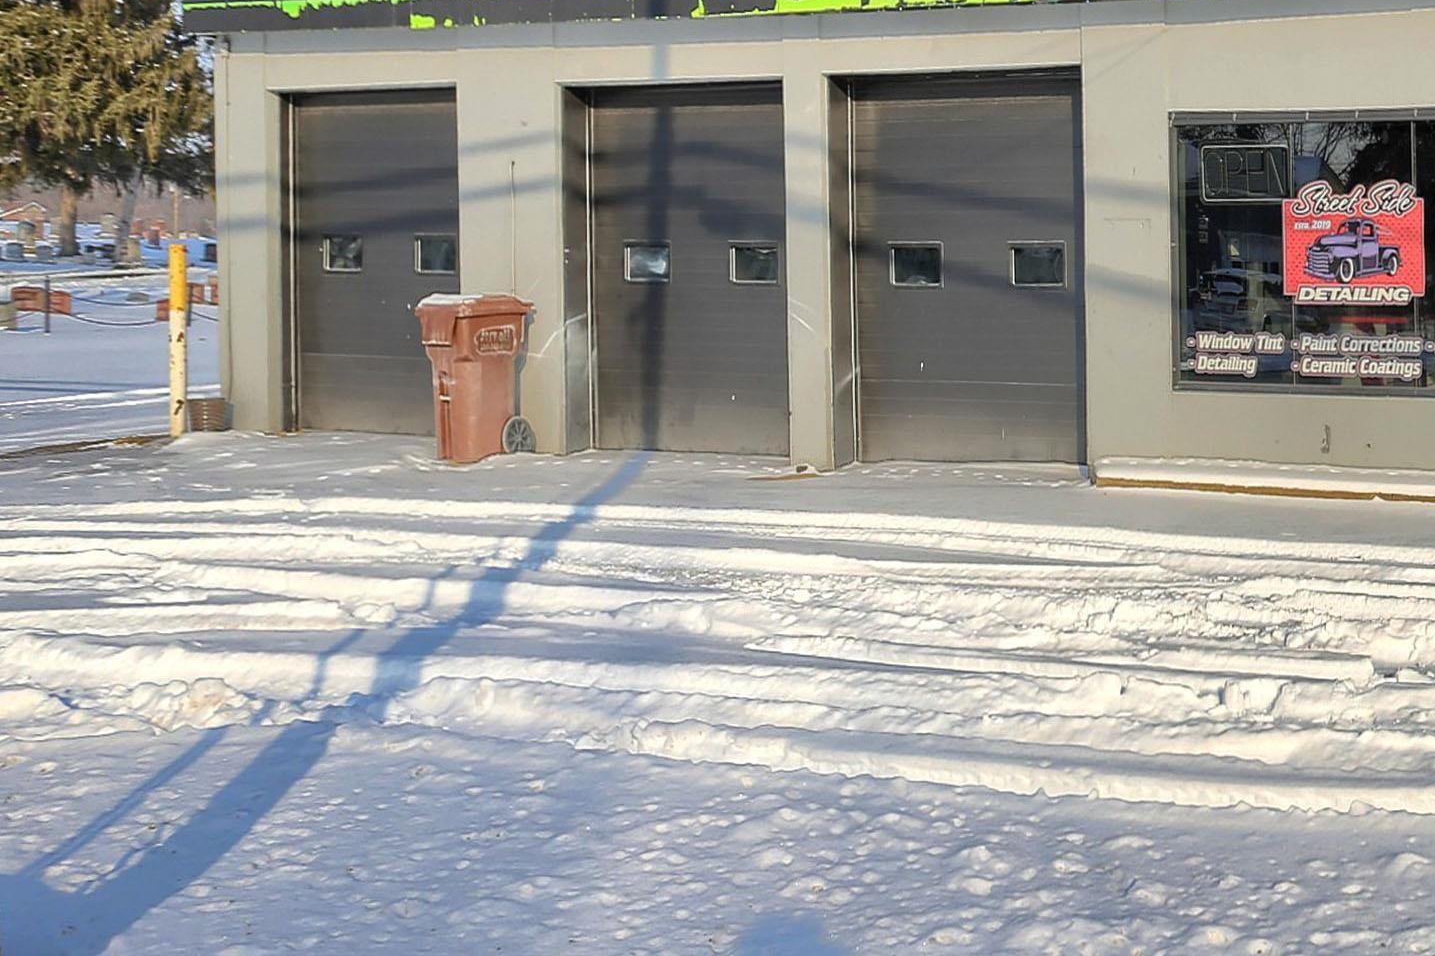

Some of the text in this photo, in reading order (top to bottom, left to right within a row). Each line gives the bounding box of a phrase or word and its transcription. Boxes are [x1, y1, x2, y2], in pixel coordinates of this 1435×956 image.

[1205, 150, 1287, 196] OPEN
[1293, 182, 1416, 215] Street Side
[1312, 220, 1331, 230] 2019
[1298, 287, 1410, 302] DETAILING
[1198, 334, 1283, 350] Window Tint
[1301, 336, 1421, 353] Paint Corrections
[1197, 355, 1257, 375] Detailing
[1301, 357, 1421, 378] Ceramic Coatings
